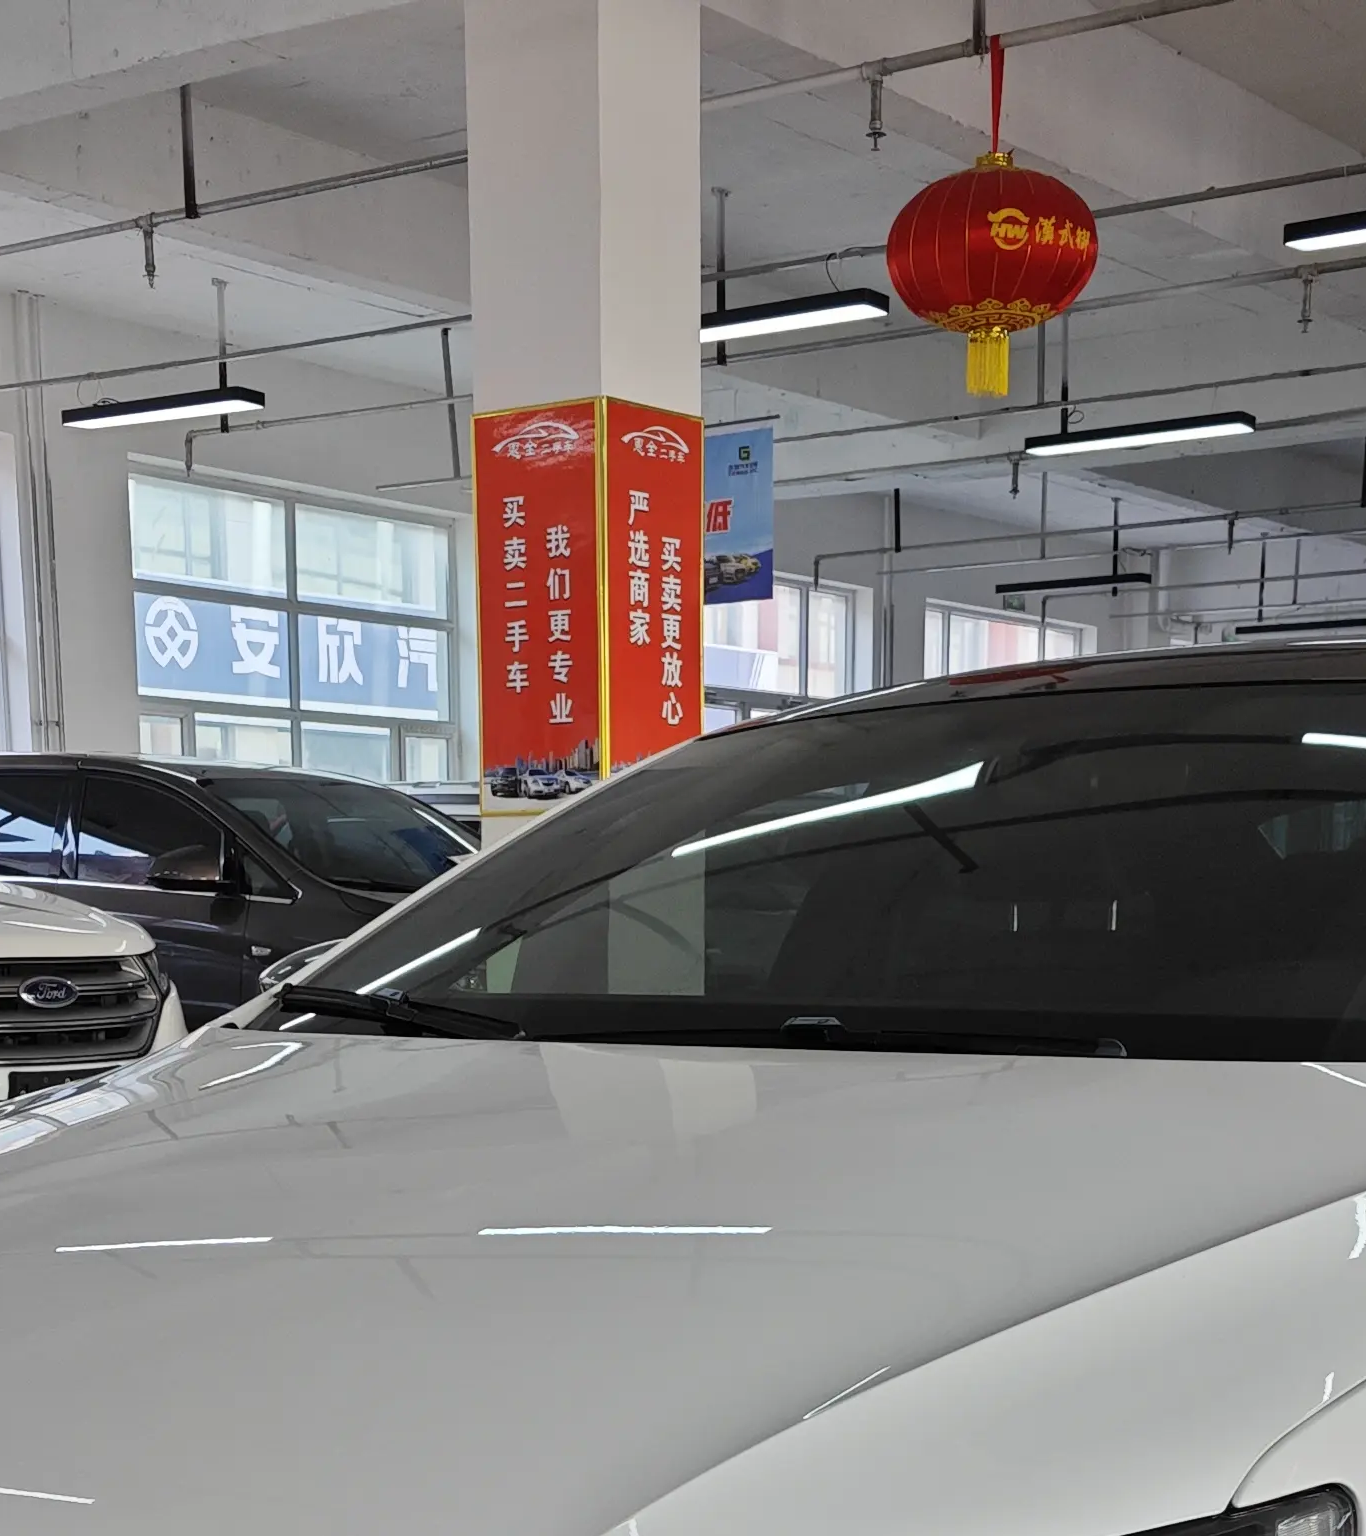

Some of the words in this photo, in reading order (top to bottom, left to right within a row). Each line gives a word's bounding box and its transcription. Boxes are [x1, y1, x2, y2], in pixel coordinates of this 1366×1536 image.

[503, 495, 529, 693] 买卖二手车
[546, 524, 573, 725] 我们更专业
[628, 490, 651, 646] 严选商家
[661, 536, 684, 726] 买卖更放心
[36, 982, 67, 1000] Ford
